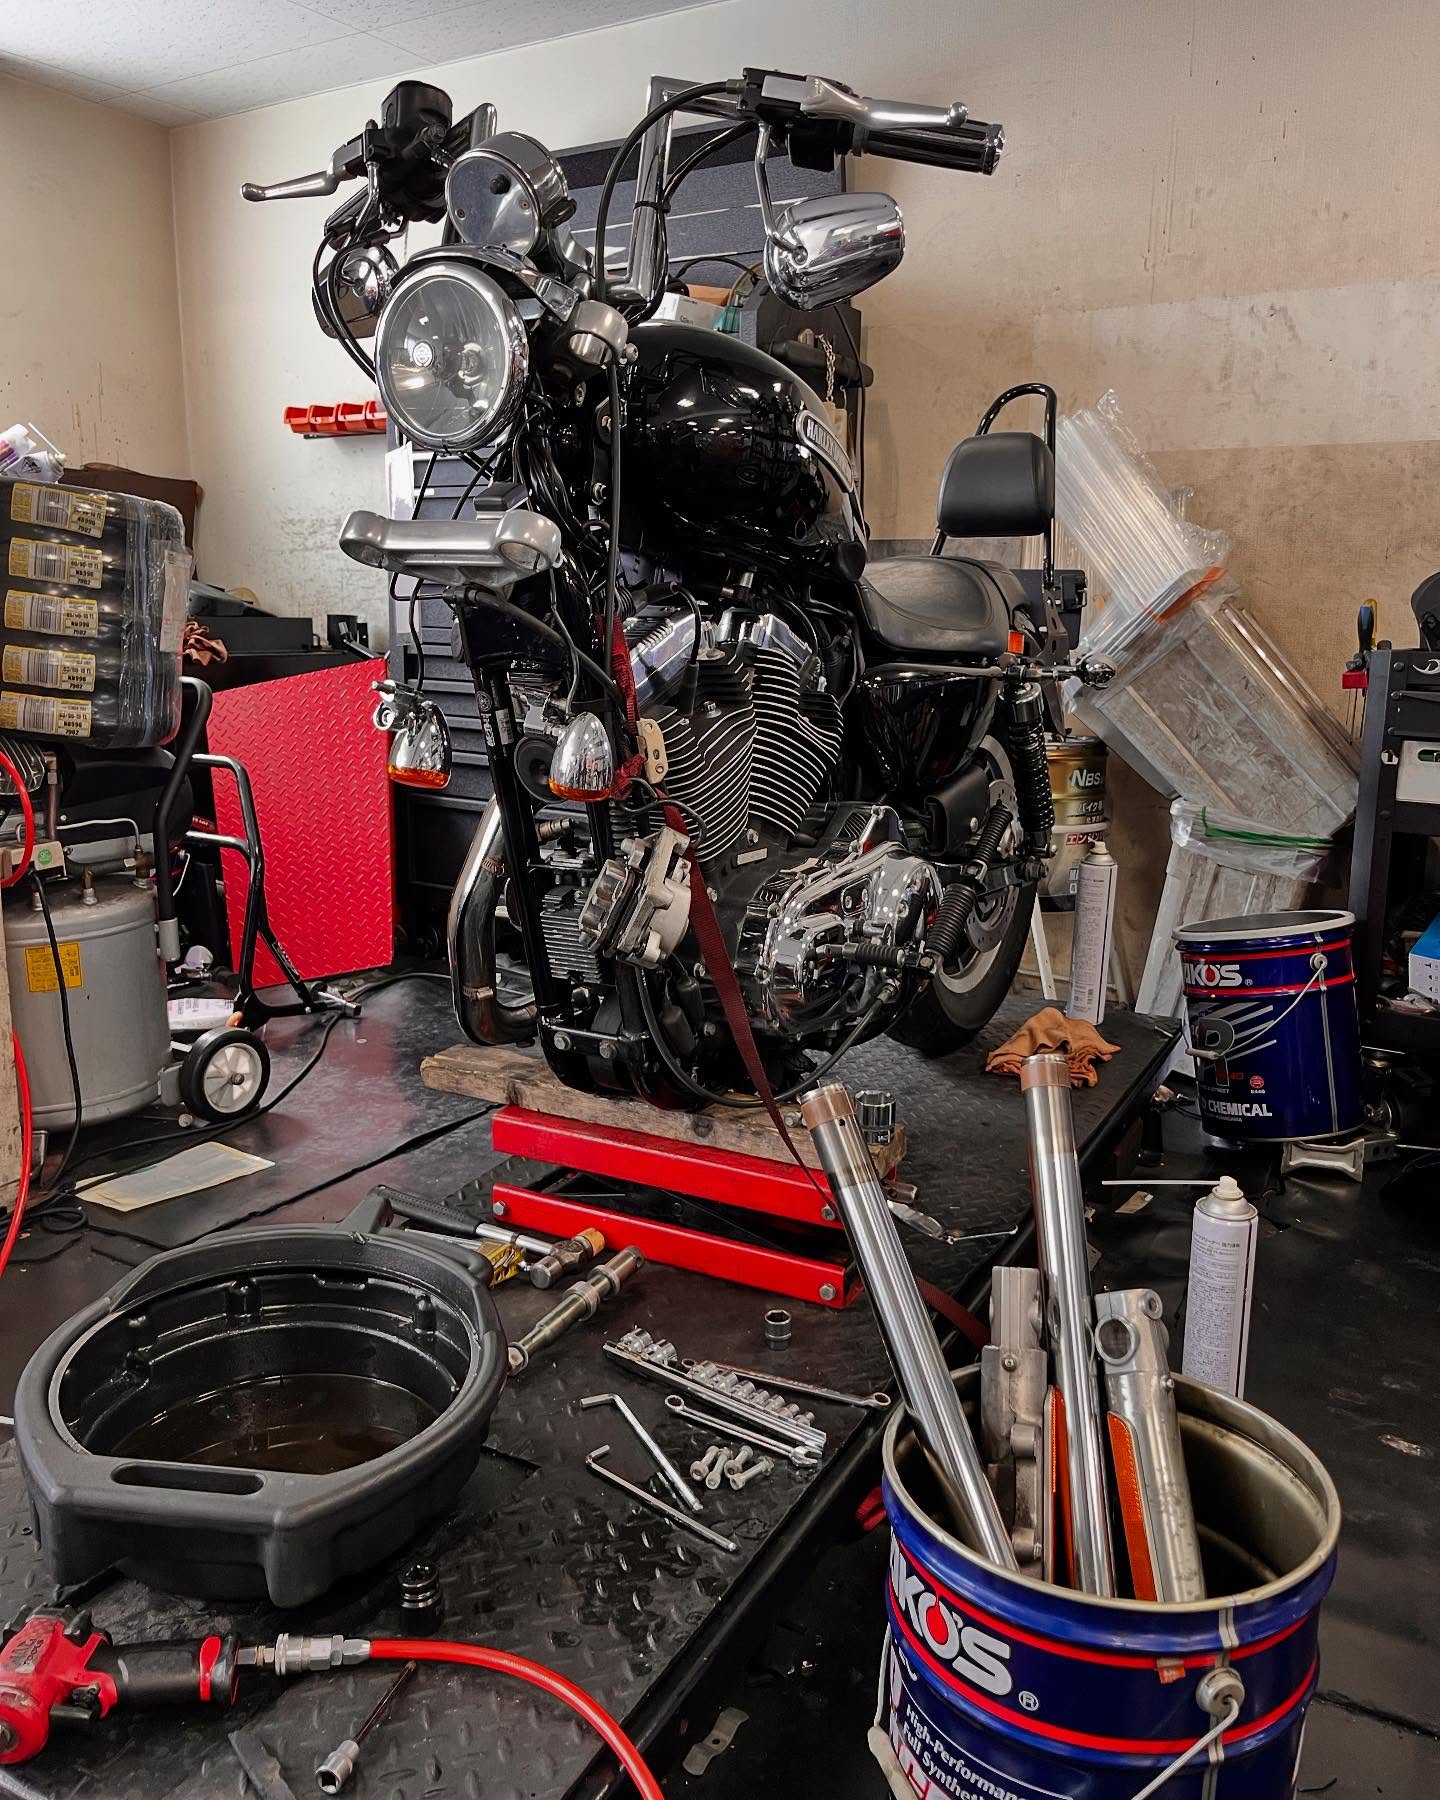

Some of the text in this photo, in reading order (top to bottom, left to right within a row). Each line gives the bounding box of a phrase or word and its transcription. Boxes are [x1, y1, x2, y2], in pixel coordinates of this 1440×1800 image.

[1208, 1099, 1272, 1117] CHEMICAL
[889, 1526, 1013, 1697] AKO'S
[903, 1720, 922, 1756] Full
[906, 1703, 1028, 1800] High-Performan
